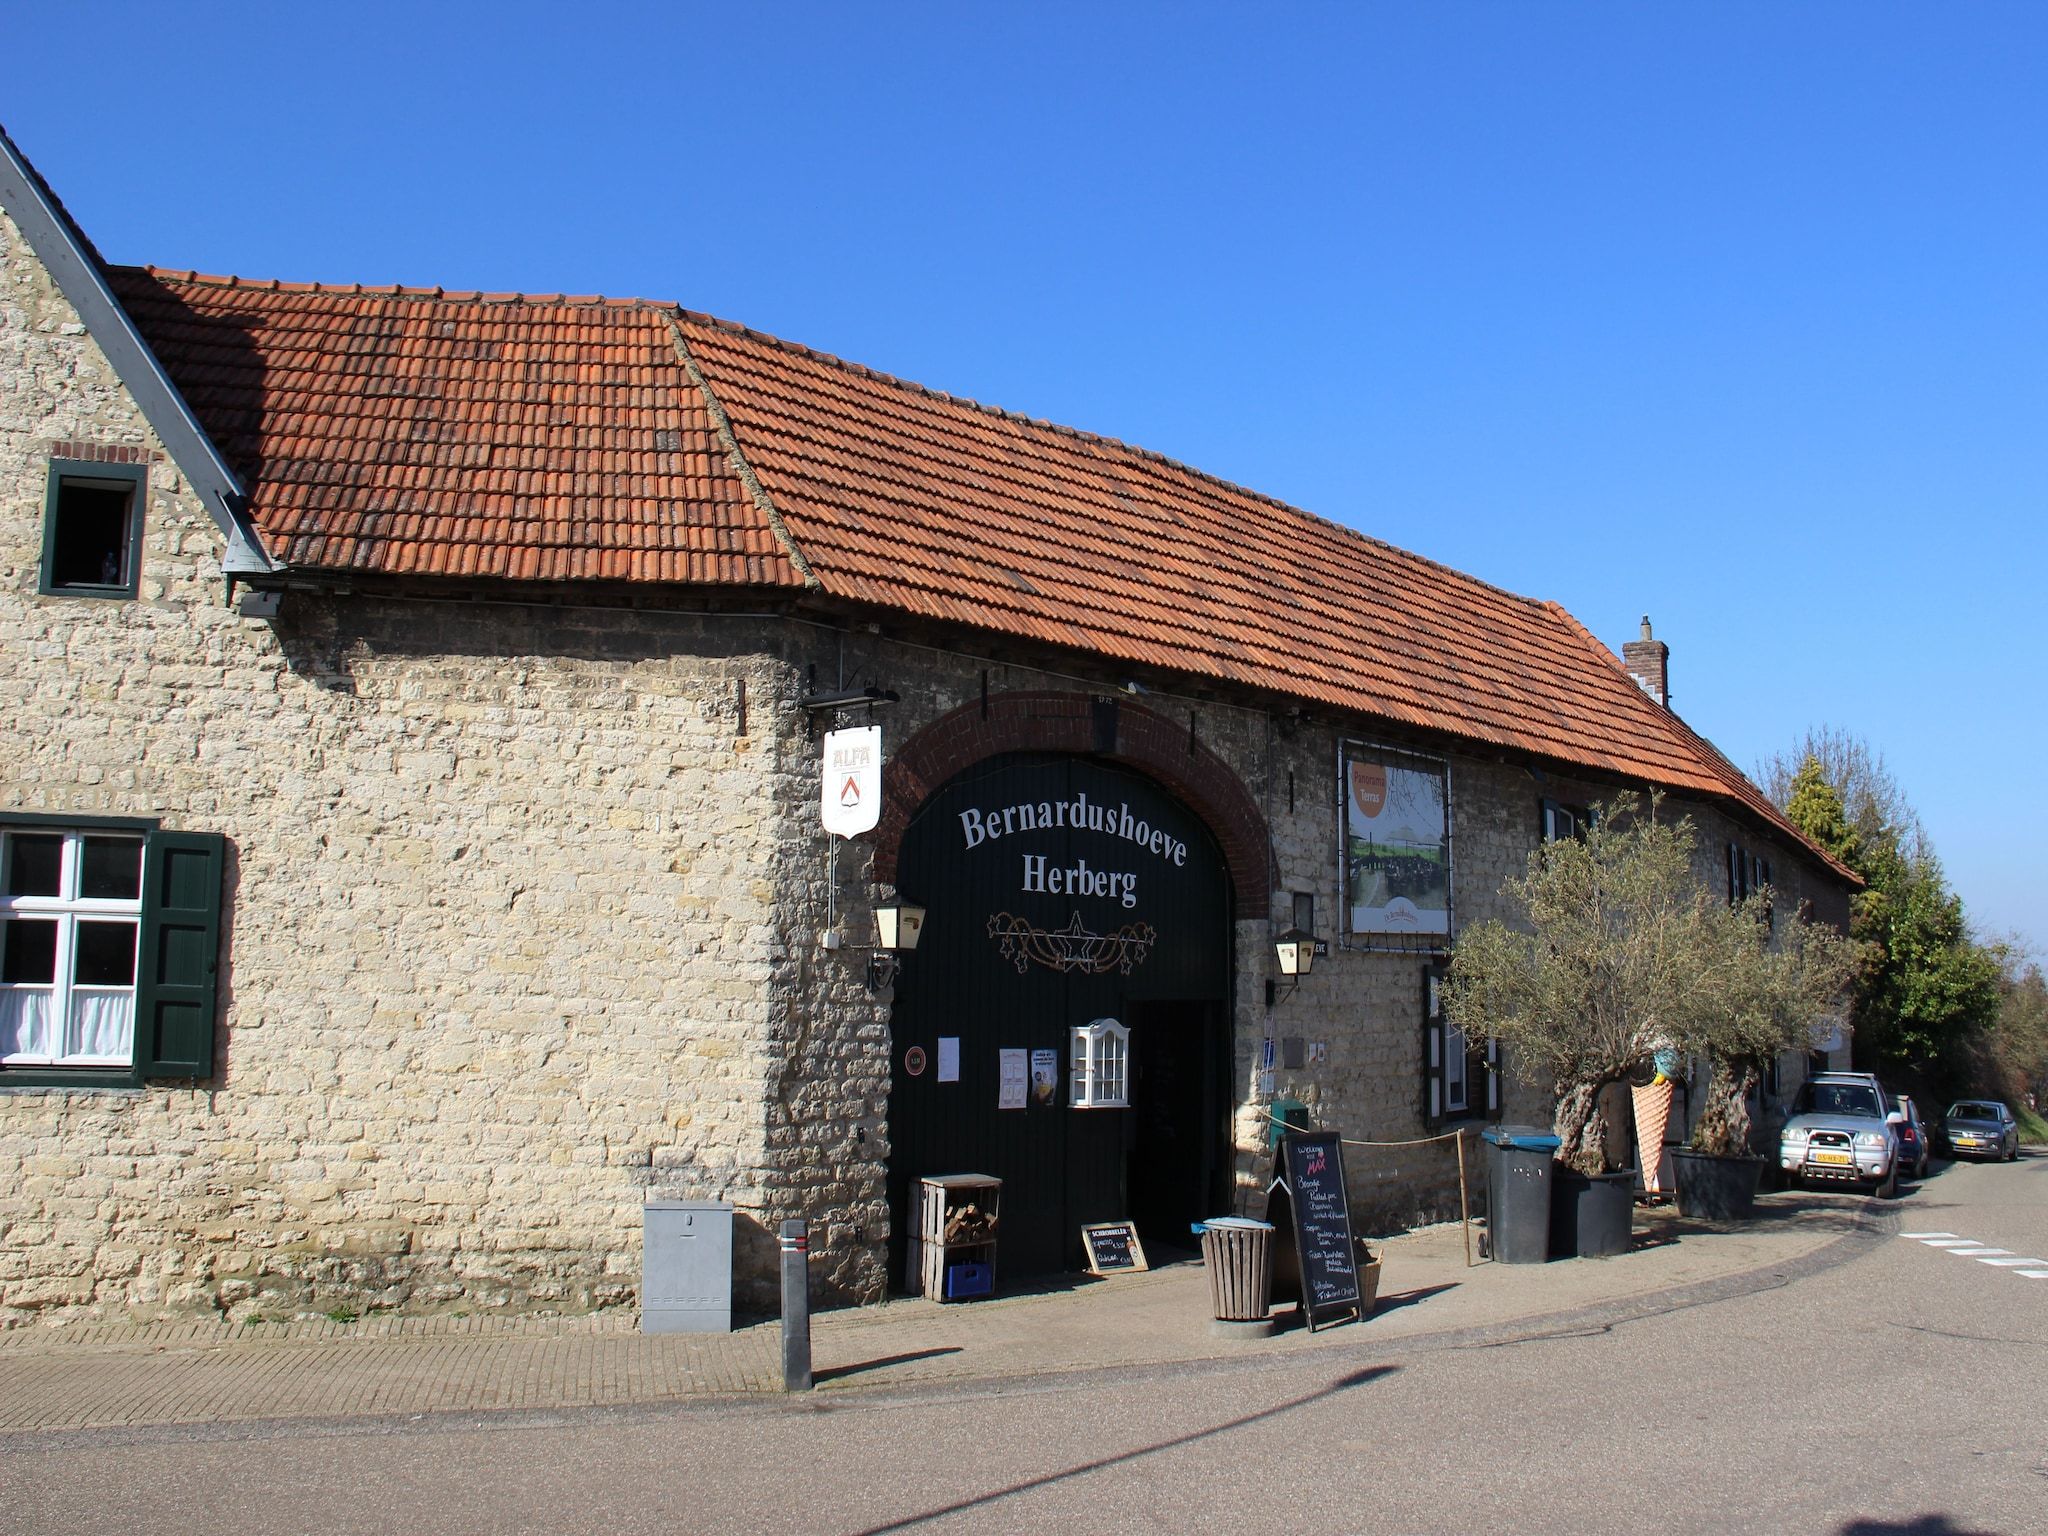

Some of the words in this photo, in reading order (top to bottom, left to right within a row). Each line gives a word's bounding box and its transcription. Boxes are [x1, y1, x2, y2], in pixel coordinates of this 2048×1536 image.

[833, 746, 871, 768] ALFA
[1354, 770, 1385, 787] Panorama
[1360, 788, 1381, 803] Terras
[958, 792, 1187, 867] Bernardushoeve
[1021, 854, 1137, 909] Herberg
